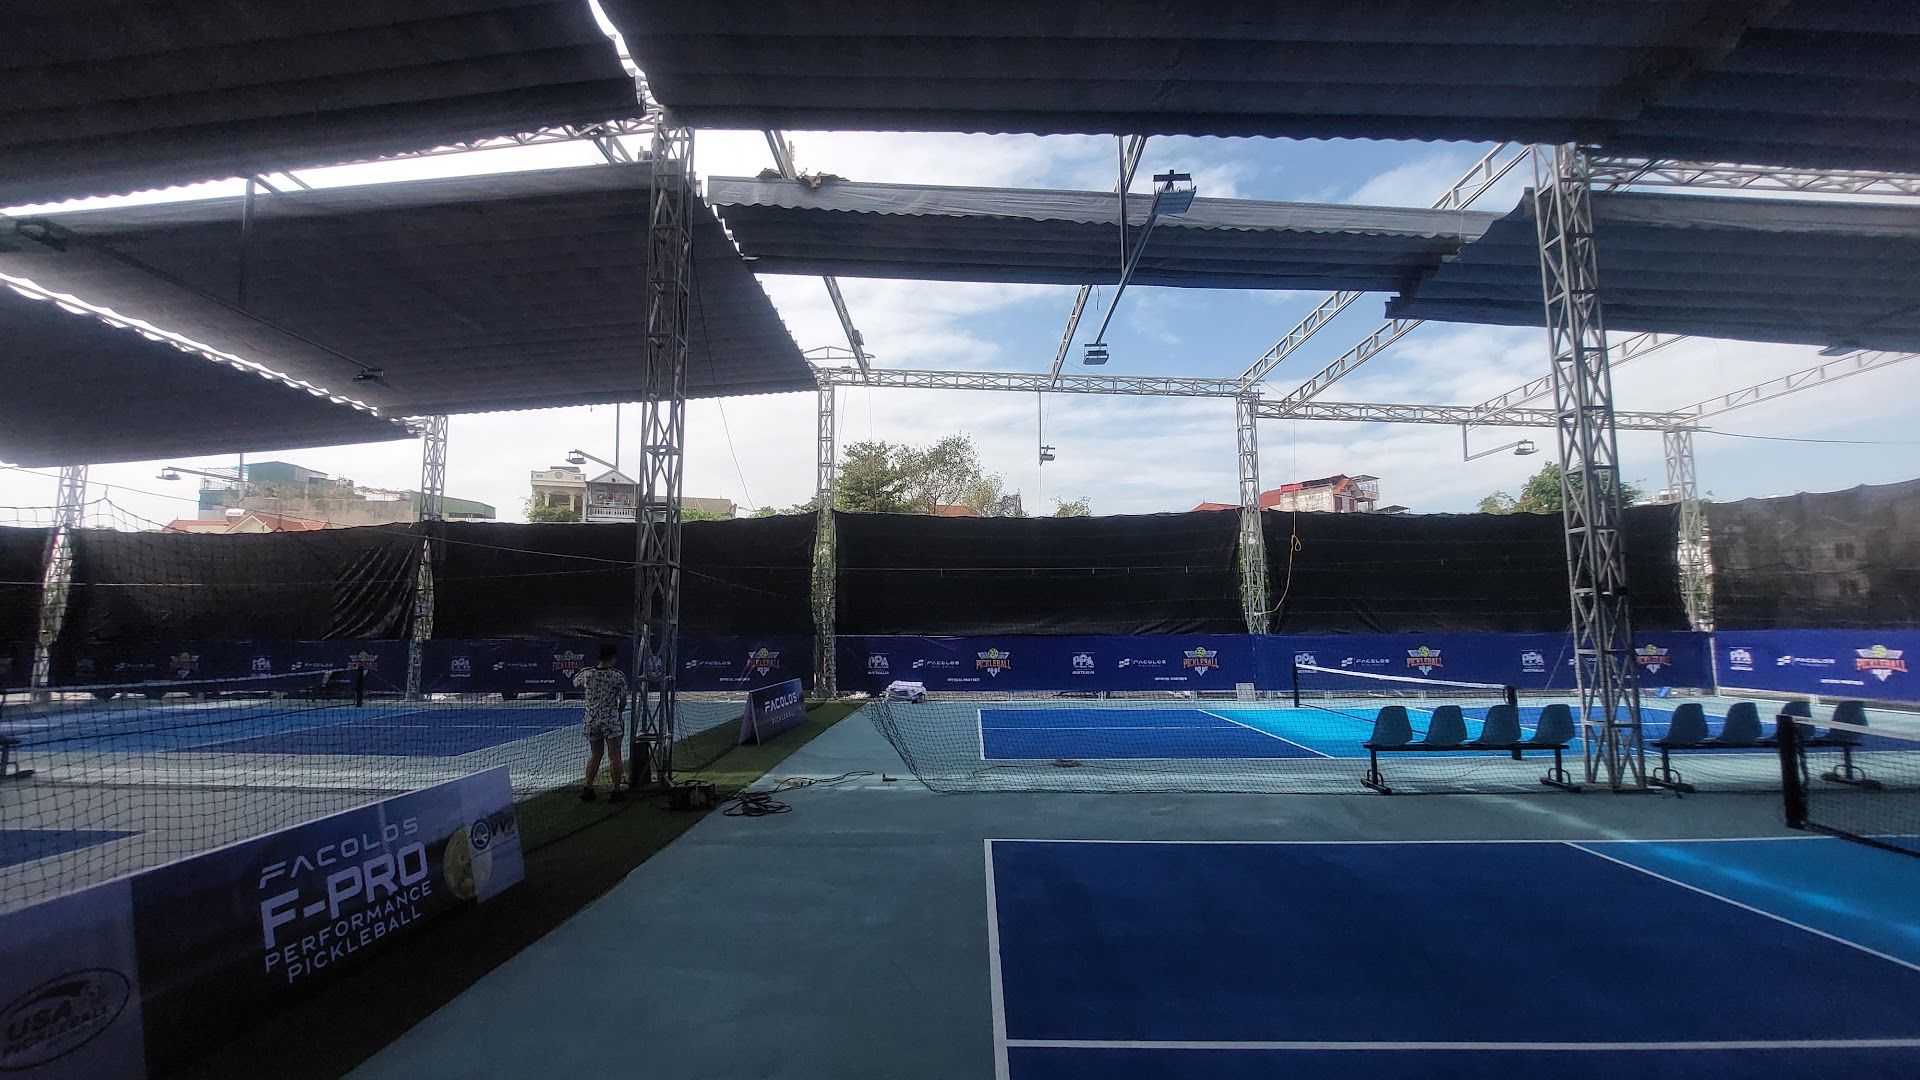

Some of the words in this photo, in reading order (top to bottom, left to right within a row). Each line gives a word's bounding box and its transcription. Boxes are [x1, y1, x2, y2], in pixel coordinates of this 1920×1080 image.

[975, 659, 1012, 670] PICKLEBALL
[1073, 654, 1094, 666] PPA
[1183, 658, 1220, 669] PICKLEBALL
[1406, 657, 1444, 668] PICKLEBALL
[1522, 652, 1544, 666] PPA
[764, 692, 798, 713] FACOLOS
[258, 816, 419, 890] FACOLOS
[260, 841, 428, 950] F-PRO
[264, 880, 433, 974] PERFORMANCE
[287, 905, 422, 984] PICKLEBALL
[8, 998, 73, 1042] USA
